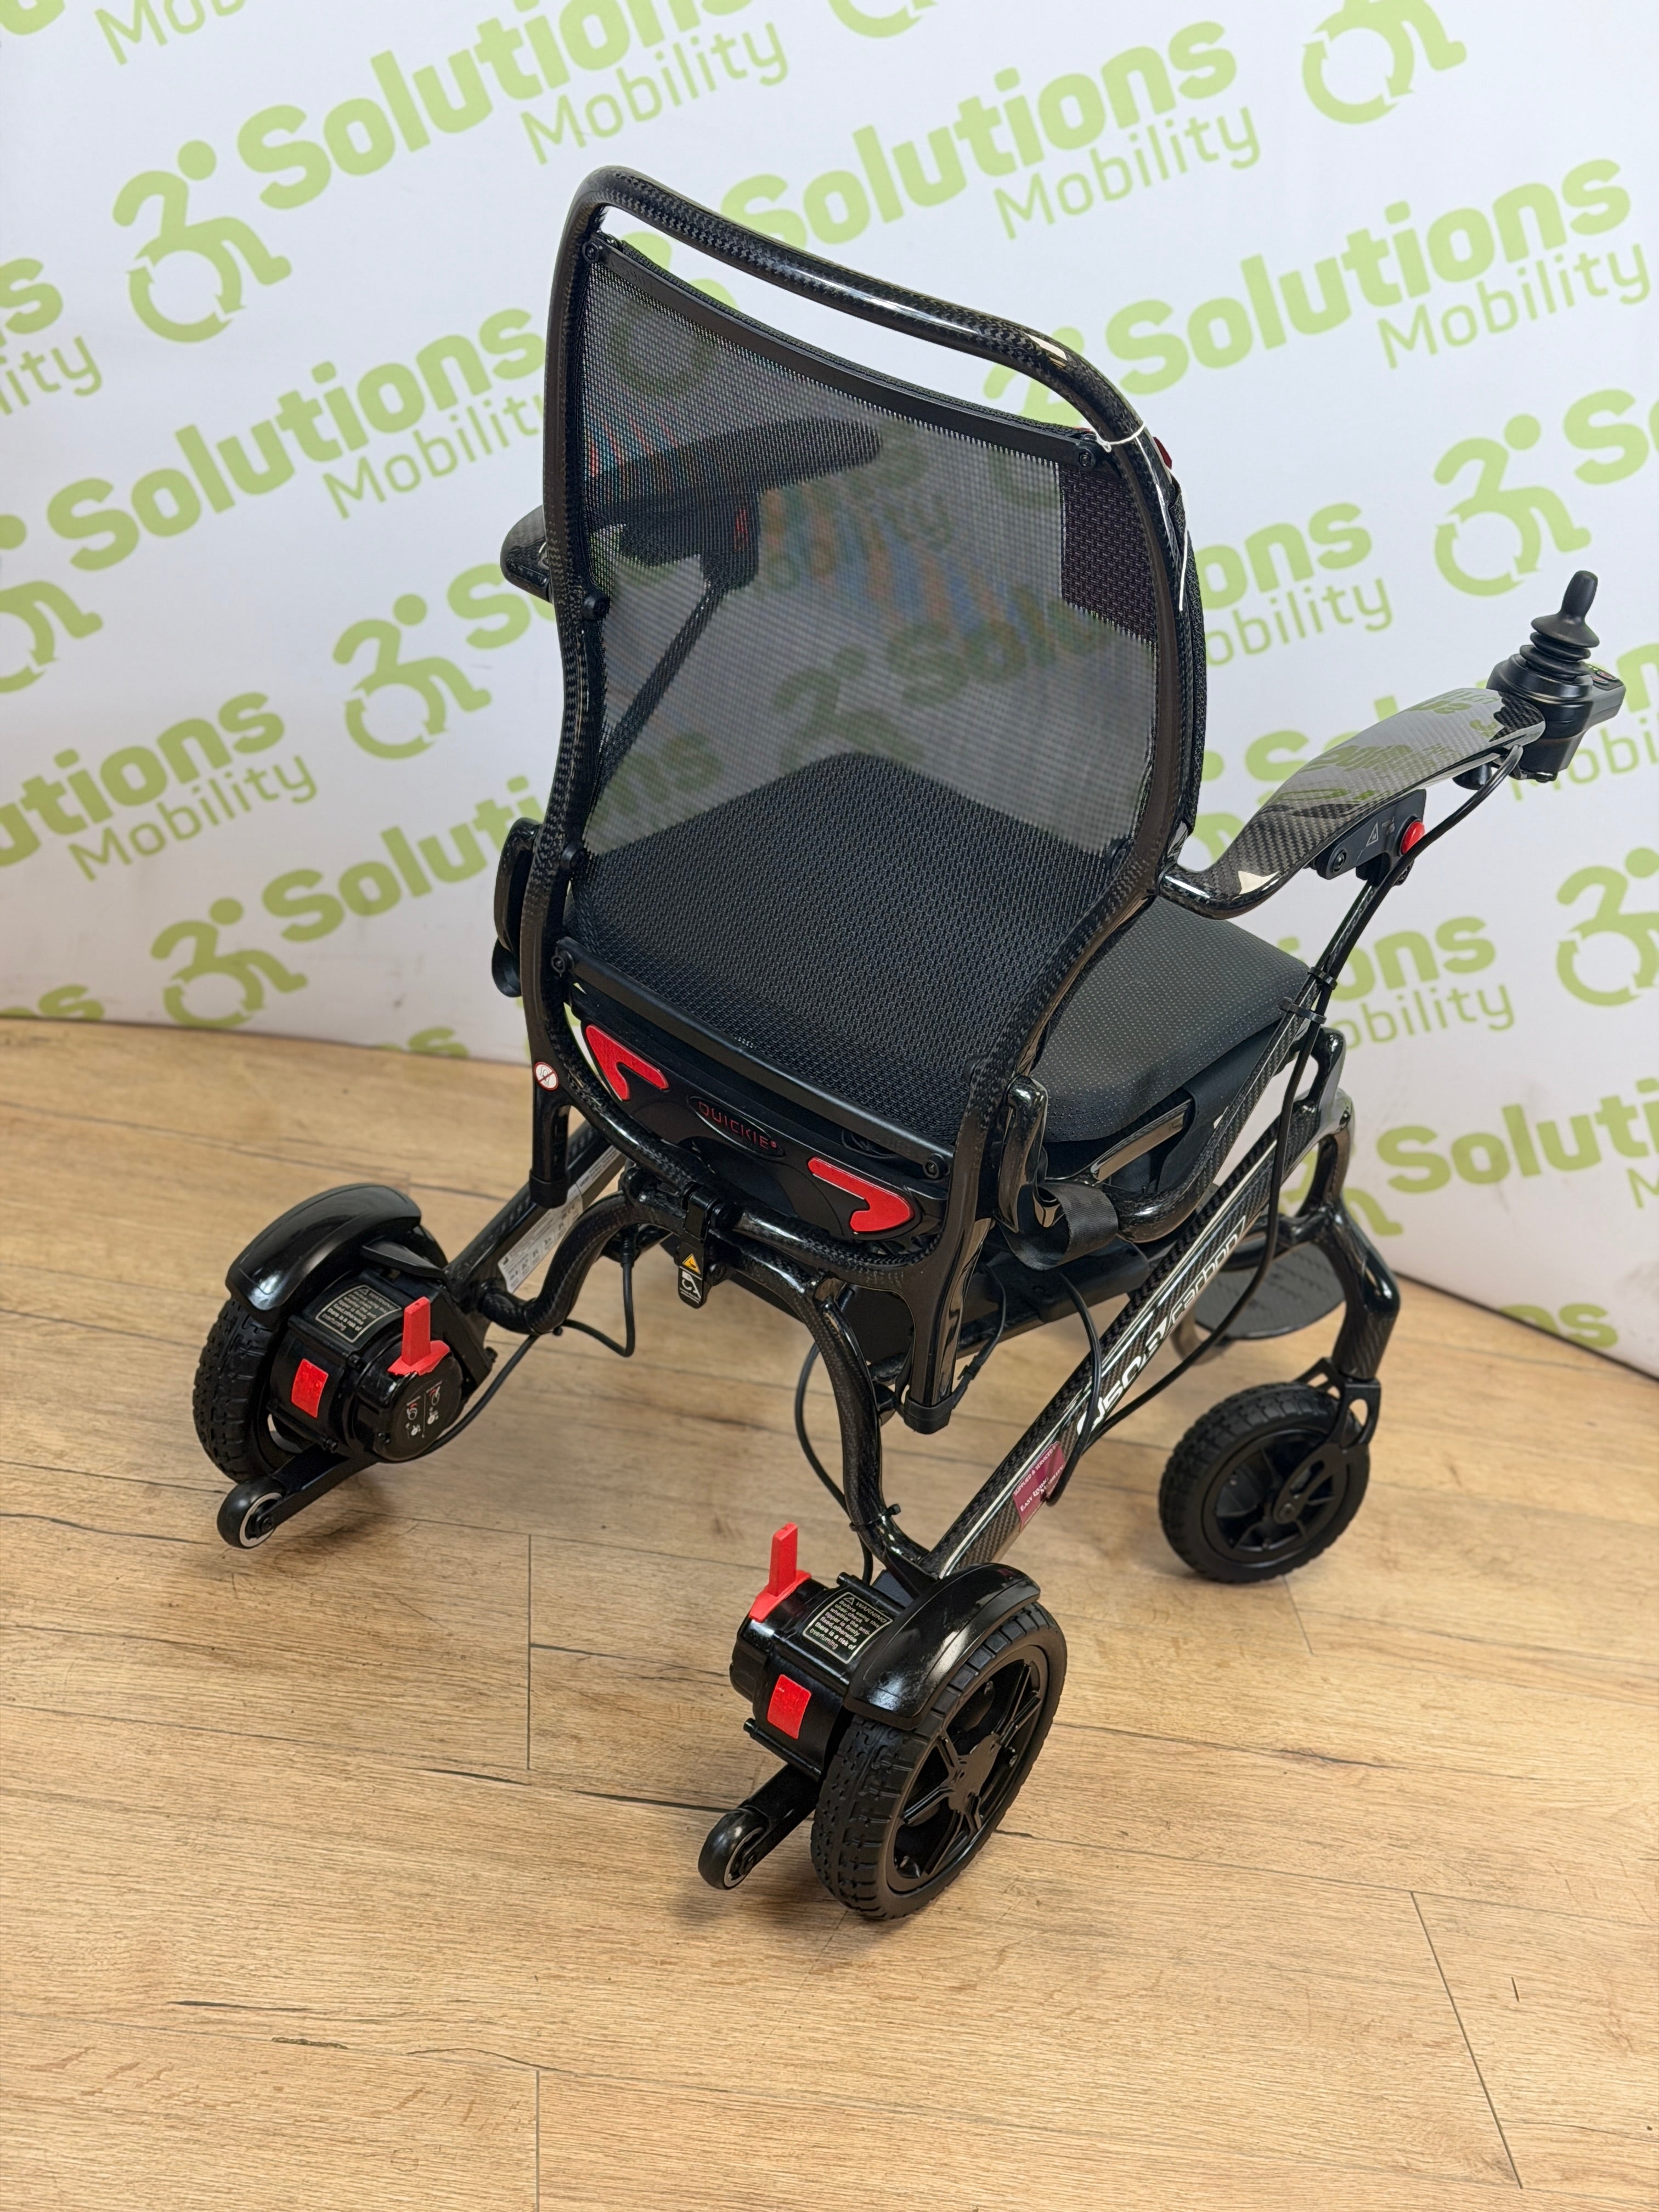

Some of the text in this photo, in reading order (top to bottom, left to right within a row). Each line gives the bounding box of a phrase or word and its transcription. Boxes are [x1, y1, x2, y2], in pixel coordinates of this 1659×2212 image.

[522, 24, 788, 163] Mobility
[721, 21, 1237, 249] Solutions
[994, 108, 1260, 240] Mobility
[1105, 160, 1631, 394] Solutions
[1378, 245, 1650, 369] Mobility
[46, 308, 545, 571] Solutions
[323, 391, 544, 519] Mobilit
[1205, 579, 1392, 665] obility
[0, 692, 285, 867] utions
[68, 756, 317, 880] Mobility
[1331, 985, 1514, 1050] obility
[1376, 1077, 1659, 1194] Soluti
[808, 1628, 839, 1649] overturning
[814, 1622, 830, 1633] there
[838, 1637, 849, 1645] risk
[824, 1612, 840, 1623] tipper
[844, 1624, 861, 1637] firmly
[829, 1607, 850, 1622] whether
[838, 1600, 856, 1612] Before
[855, 1601, 888, 1623] WARNING
